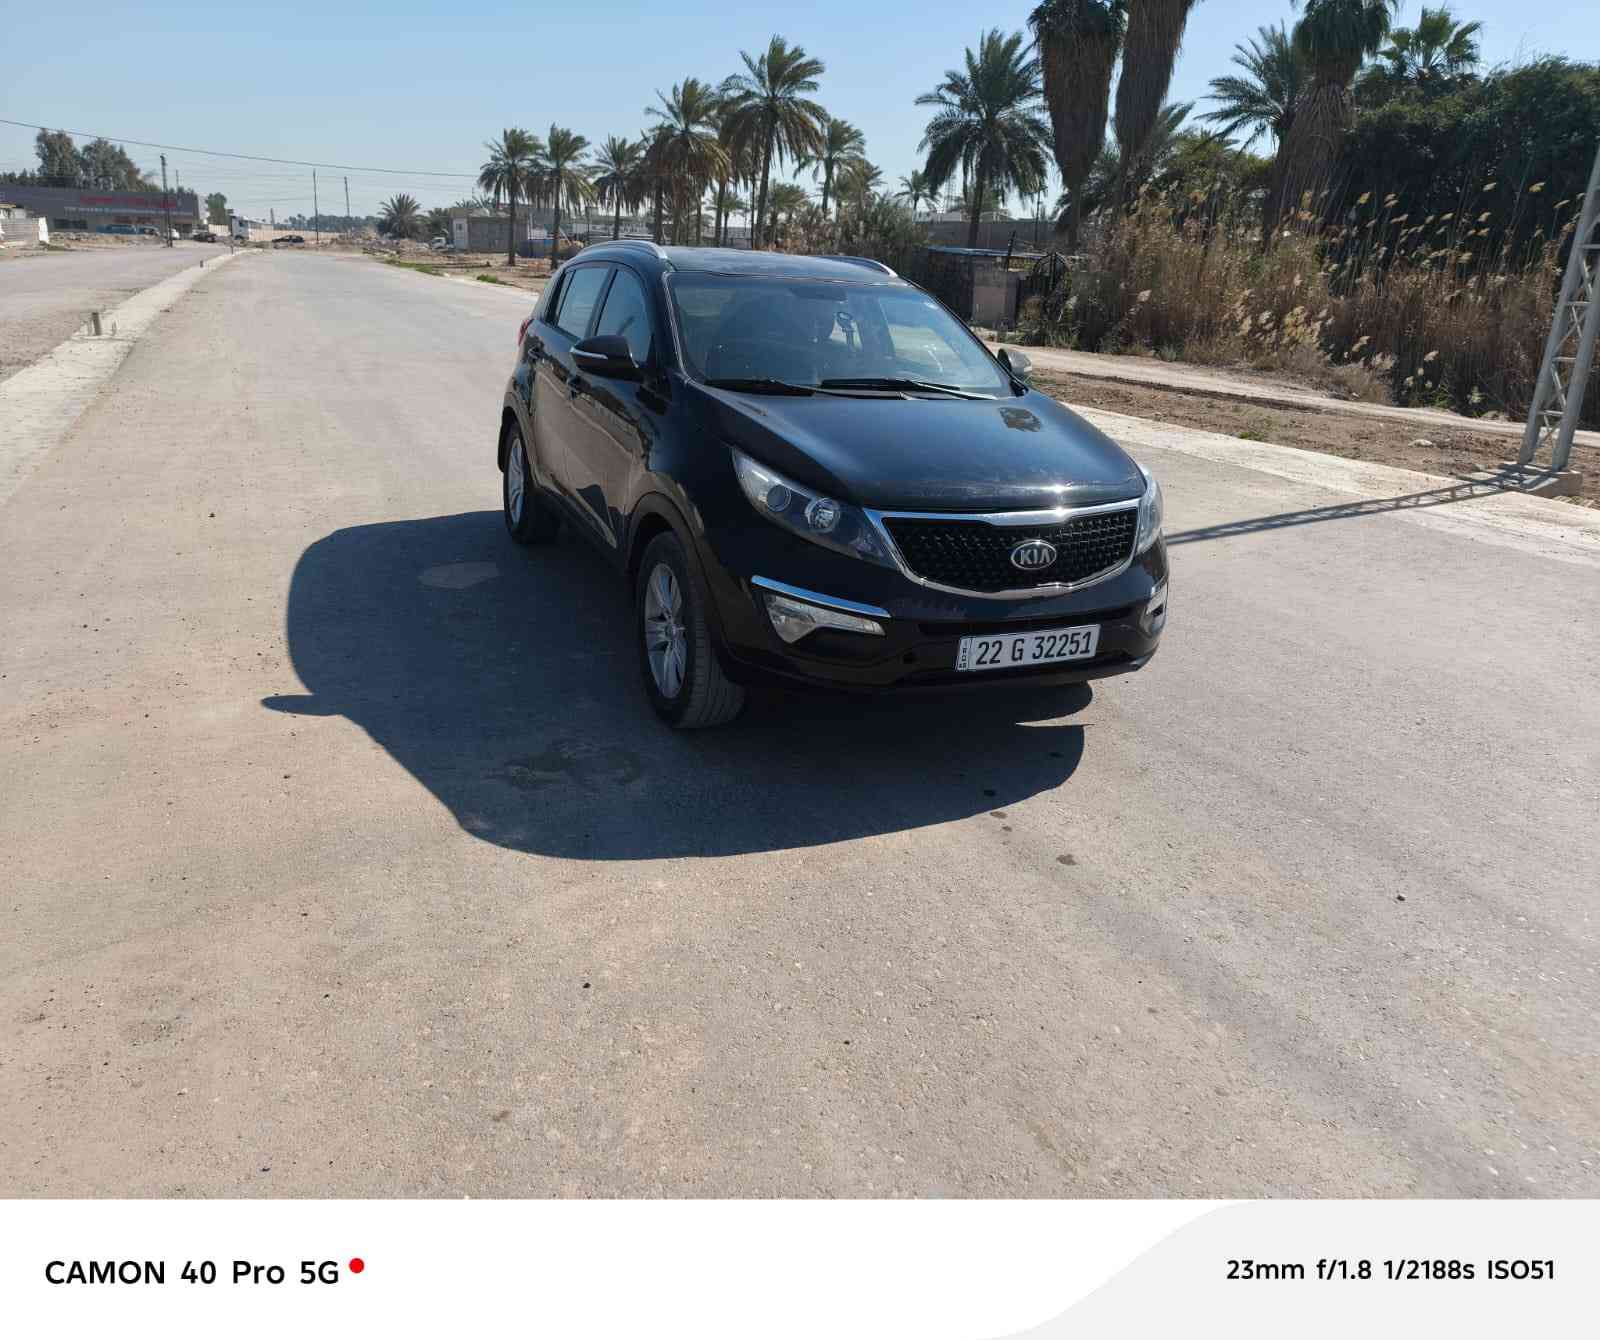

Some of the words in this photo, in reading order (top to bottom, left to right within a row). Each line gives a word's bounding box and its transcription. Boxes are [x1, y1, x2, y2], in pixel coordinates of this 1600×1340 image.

[1019, 549, 1050, 566] KIA
[976, 640, 1003, 665] 22
[1011, 638, 1025, 663] G
[1032, 631, 1092, 660] 32251
